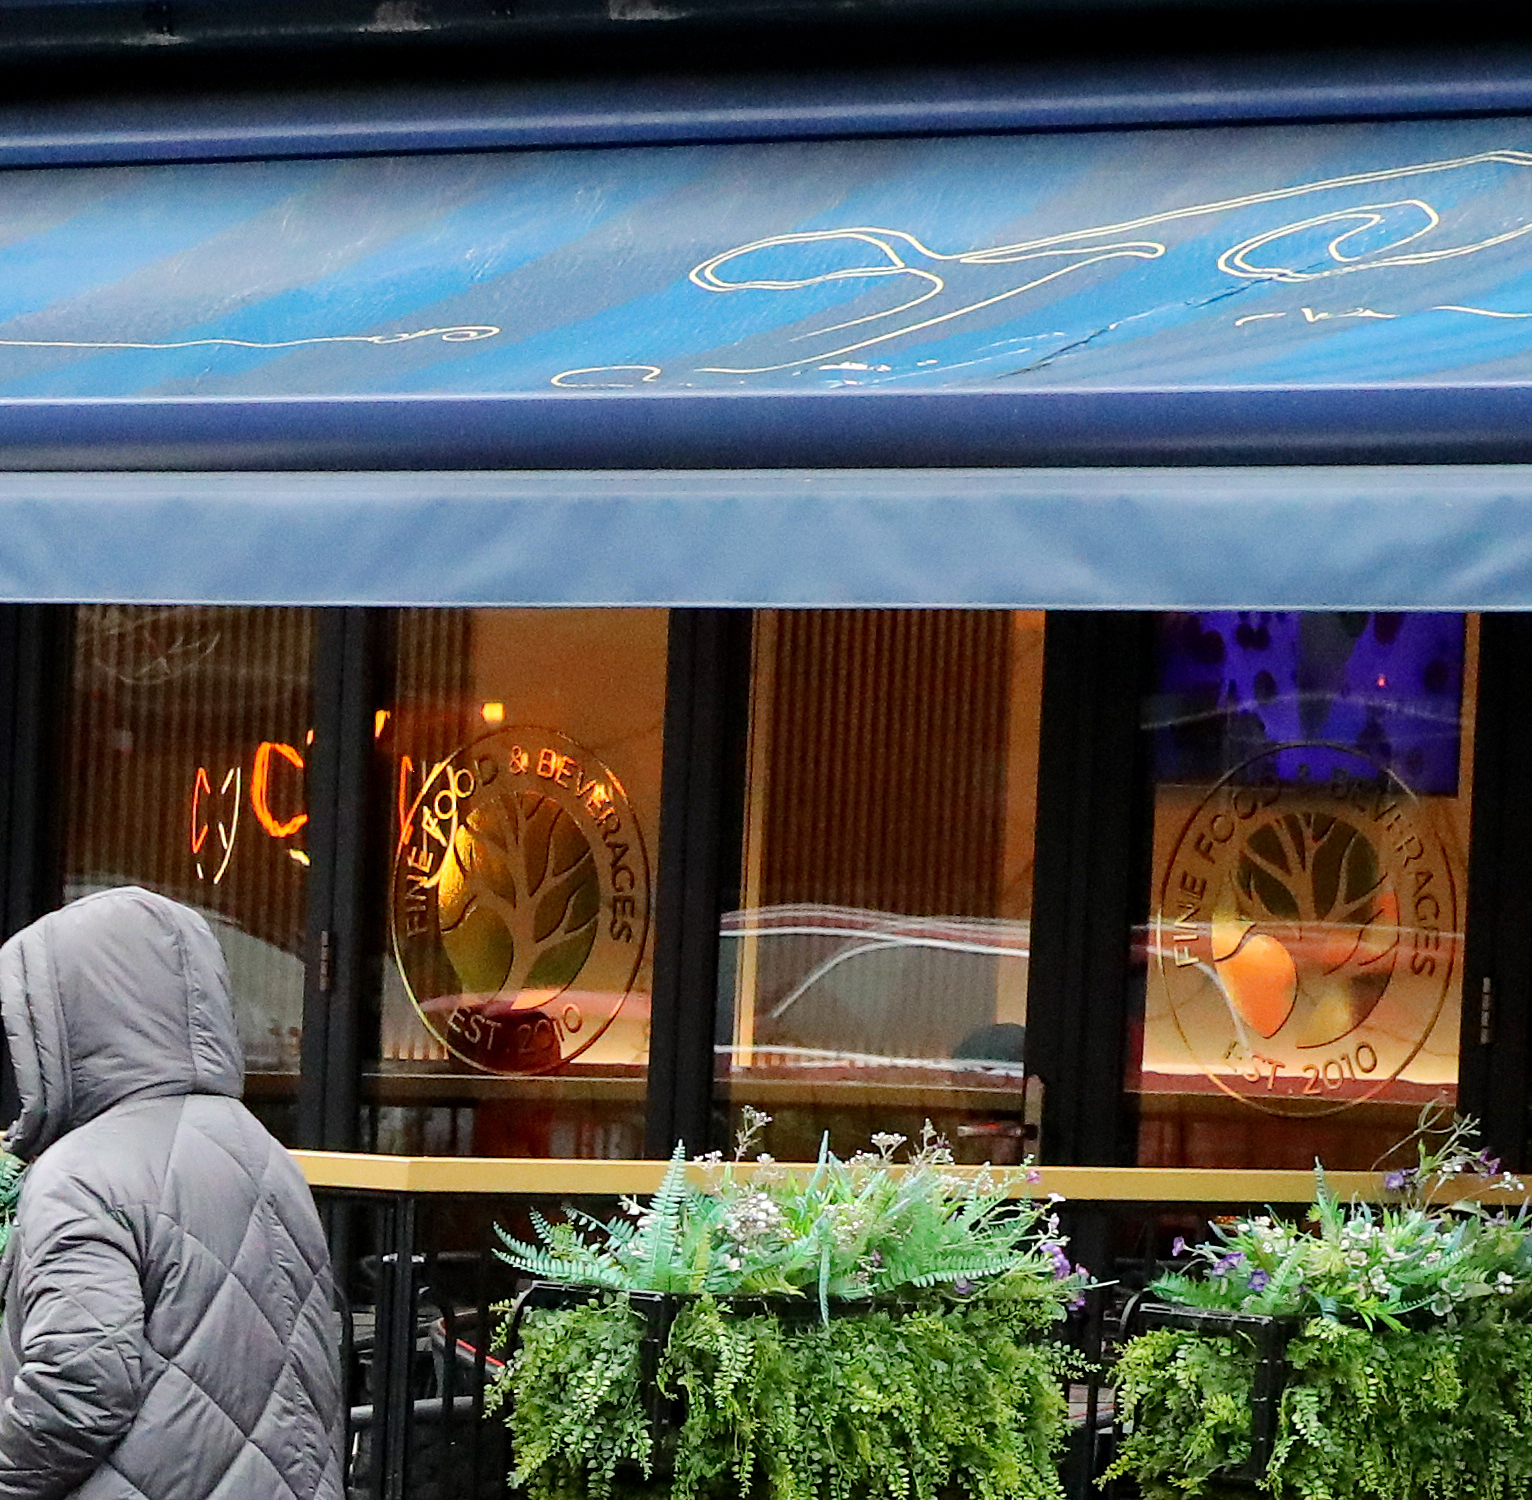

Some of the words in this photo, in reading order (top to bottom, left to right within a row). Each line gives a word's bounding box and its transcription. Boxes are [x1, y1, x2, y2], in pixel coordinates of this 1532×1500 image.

[406, 847, 434, 938] FINE
[422, 755, 500, 848] FOOD
[508, 745, 530, 775] &
[536, 748, 636, 944] BEVERAGES
[1173, 873, 1206, 968] FINE
[517, 1003, 583, 1054] 2010
[1302, 1041, 1378, 1095] 2010
